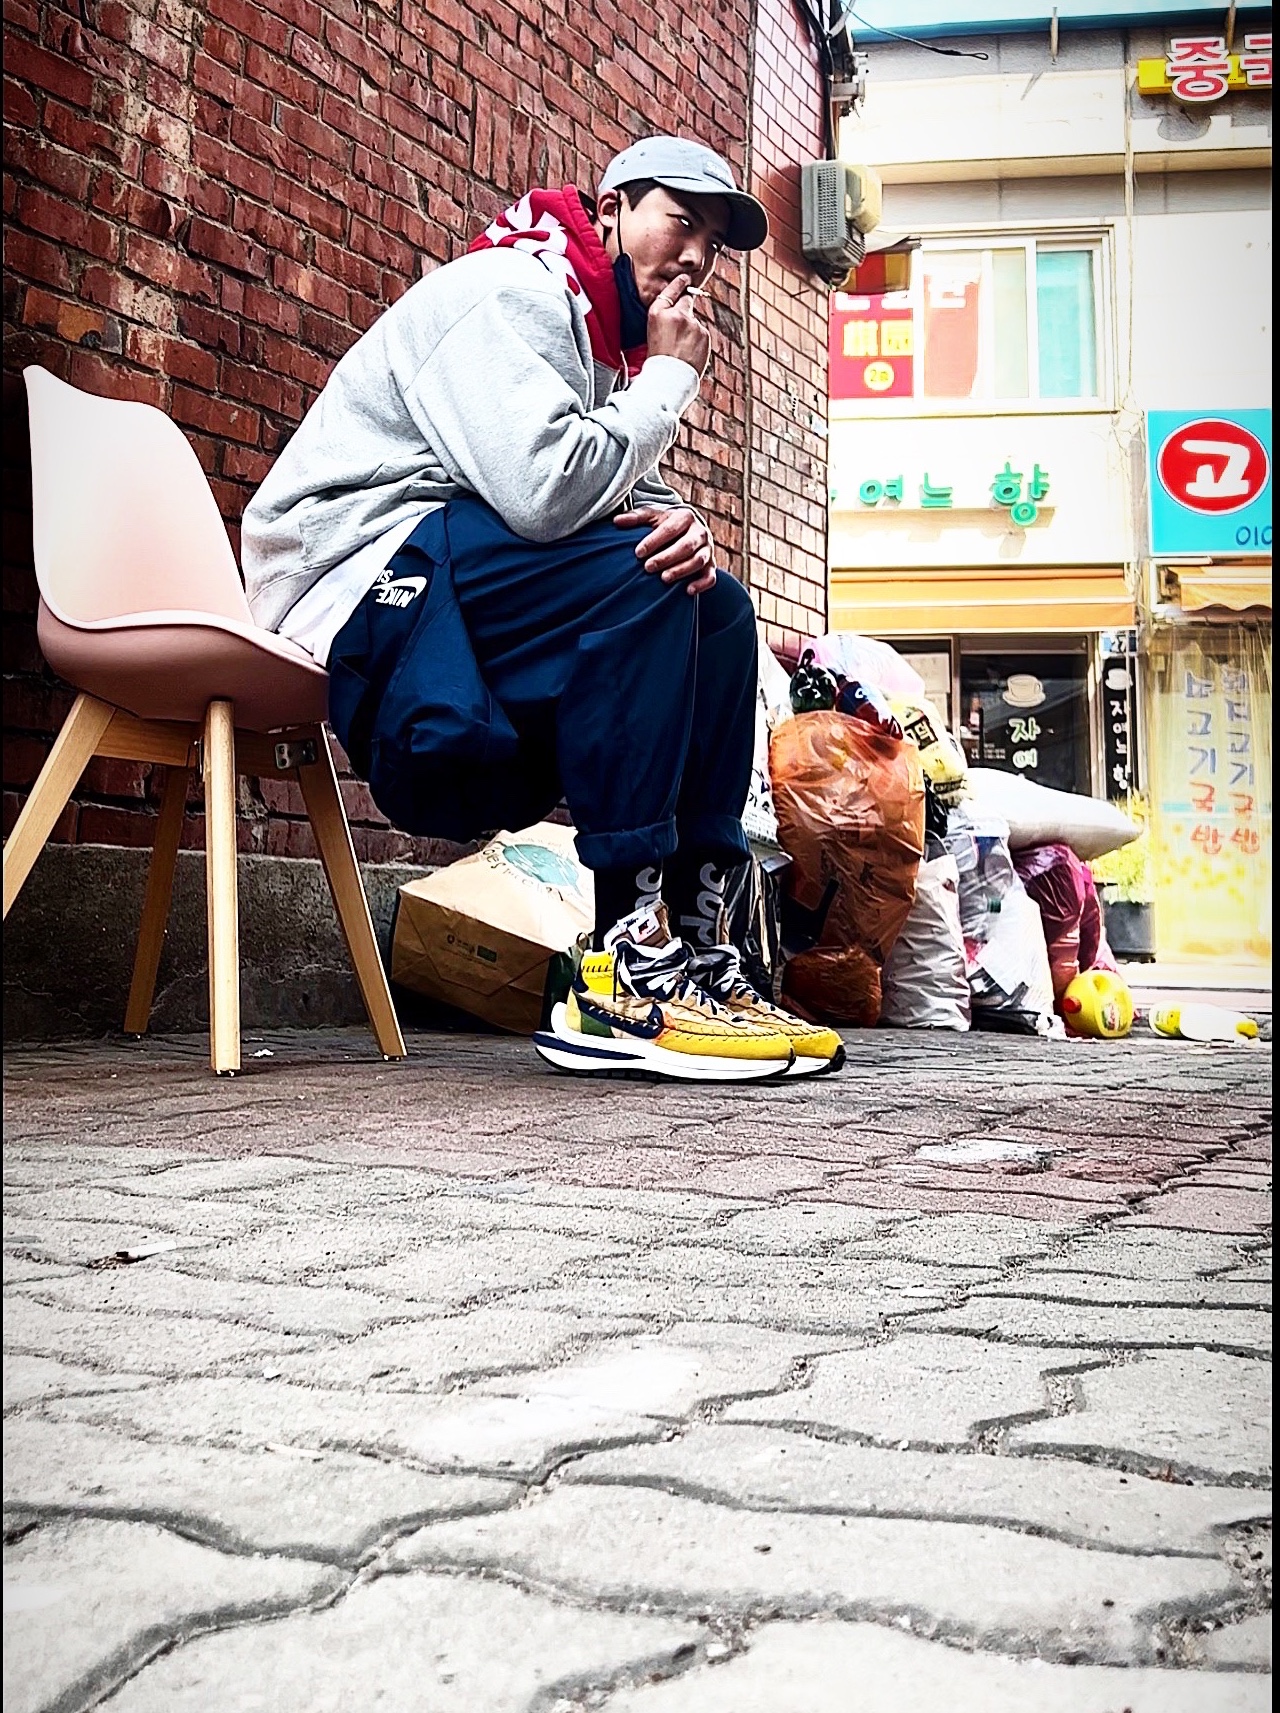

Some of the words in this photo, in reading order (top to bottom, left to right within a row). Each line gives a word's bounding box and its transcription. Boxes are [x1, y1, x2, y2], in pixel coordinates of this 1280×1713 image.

[1182, 440, 1250, 497] 고
[375, 587, 415, 608] NIKE
[1009, 716, 1042, 777] 자여
